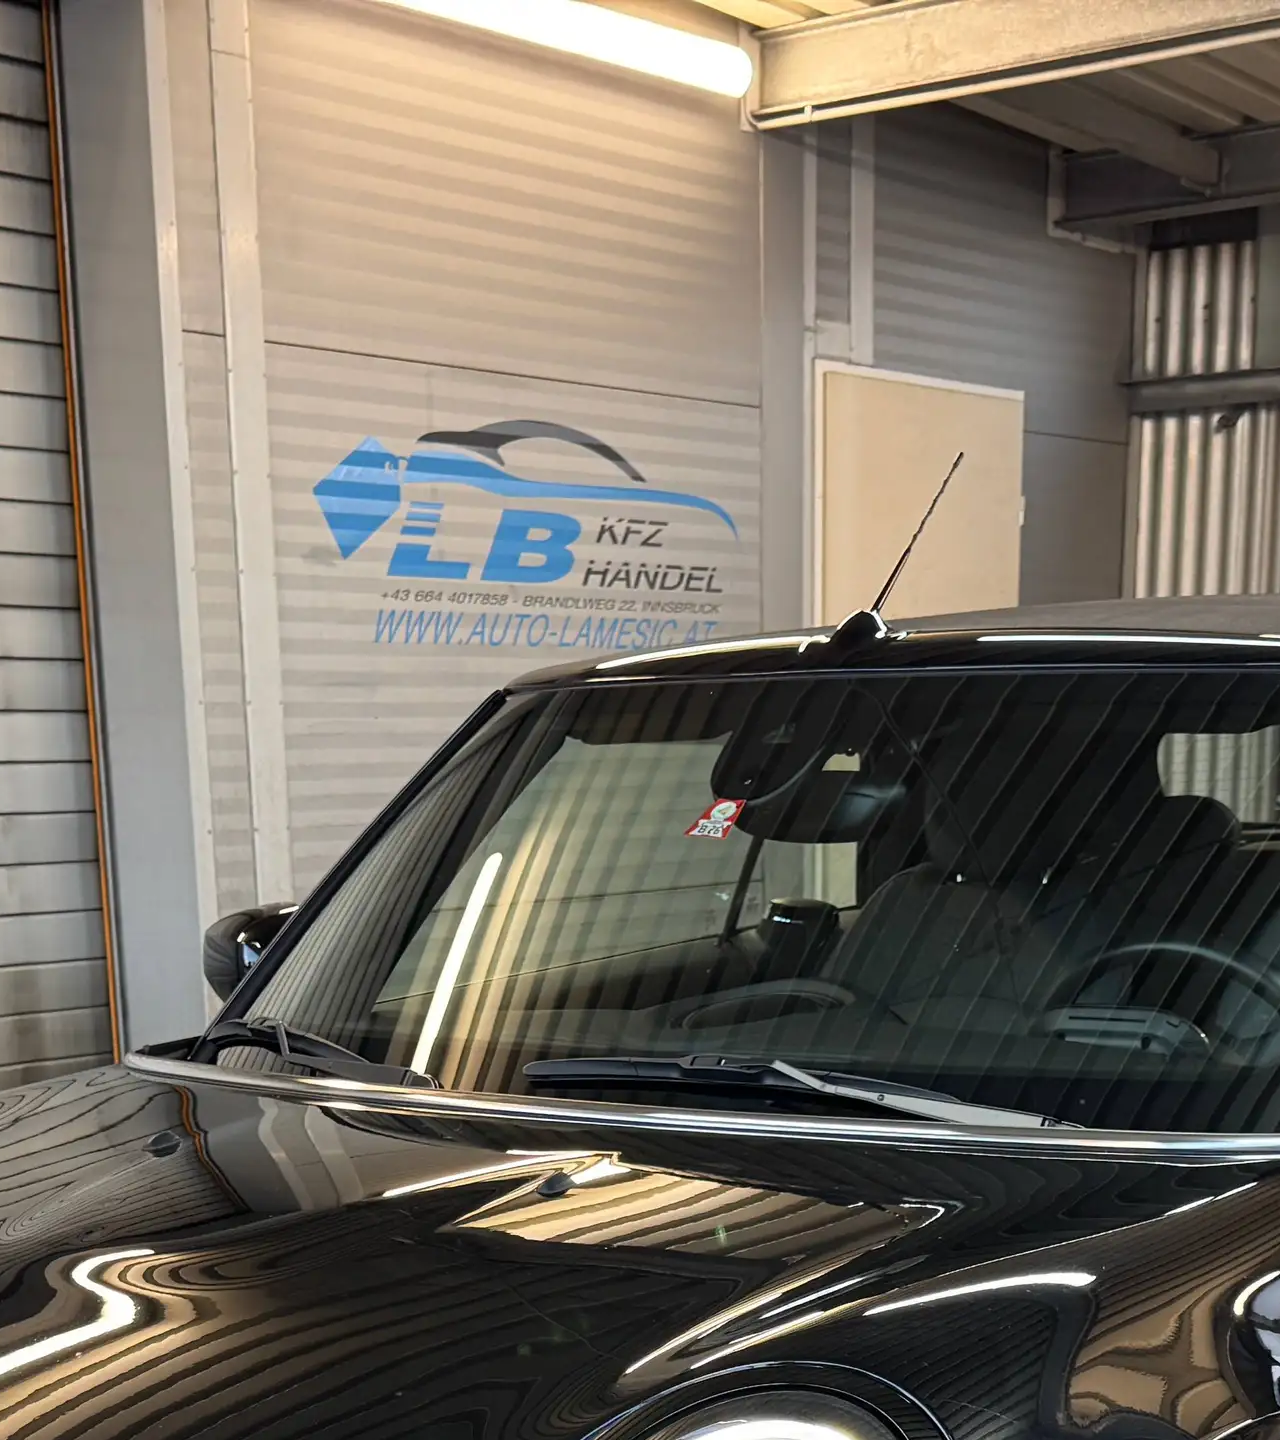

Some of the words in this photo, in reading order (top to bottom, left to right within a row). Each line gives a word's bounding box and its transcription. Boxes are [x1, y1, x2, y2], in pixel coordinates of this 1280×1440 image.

[386, 500, 582, 584] LB
[595, 515, 670, 548] KFZ
[582, 558, 723, 594] HANDEL
[381, 588, 411, 602] +43
[414, 590, 443, 603] 664
[447, 592, 509, 606] 4017858
[522, 595, 616, 612] BRANDLWEG
[641, 600, 722, 615] INNSBRUCK
[373, 607, 718, 650] WWW.AUTO-LAMESICAT
